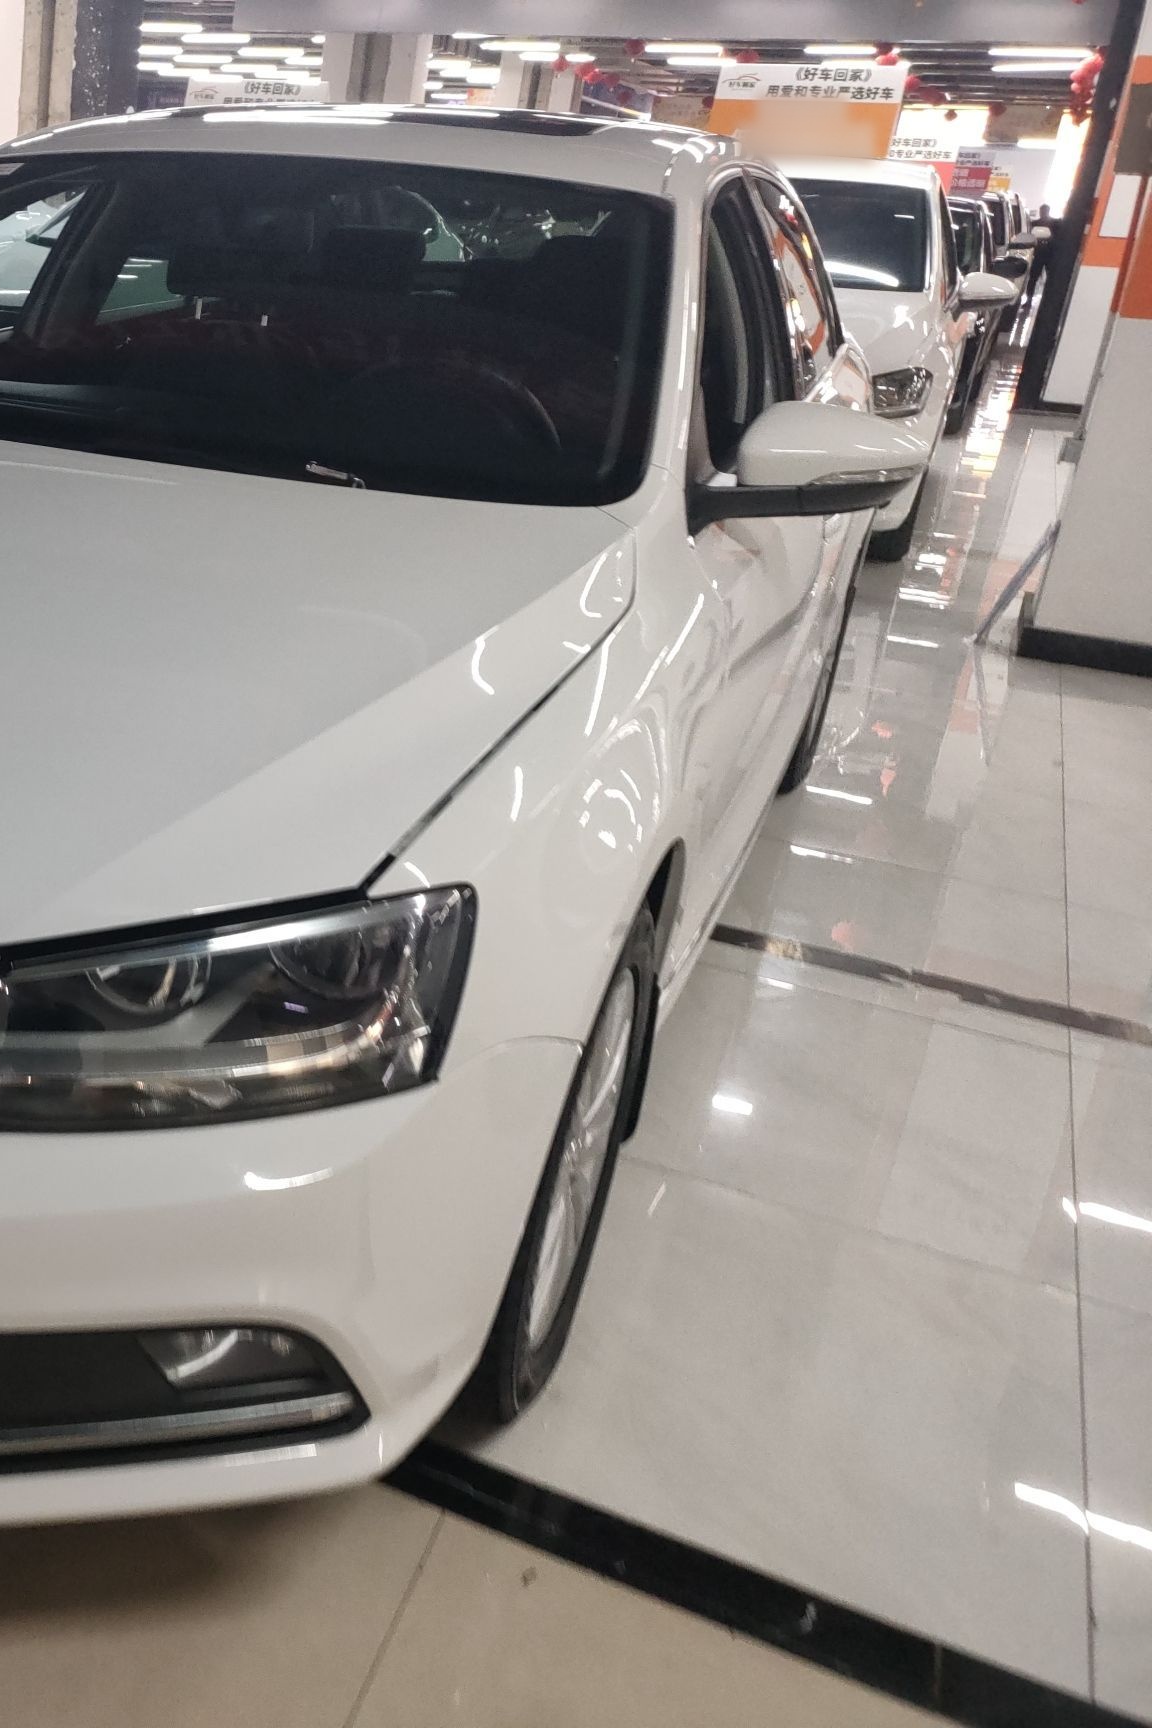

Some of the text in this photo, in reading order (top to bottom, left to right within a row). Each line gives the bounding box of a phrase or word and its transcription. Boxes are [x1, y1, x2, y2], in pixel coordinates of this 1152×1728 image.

[795, 67, 872, 82] 《好车回家》
[765, 84, 895, 100] 用爱和专业严选好车
